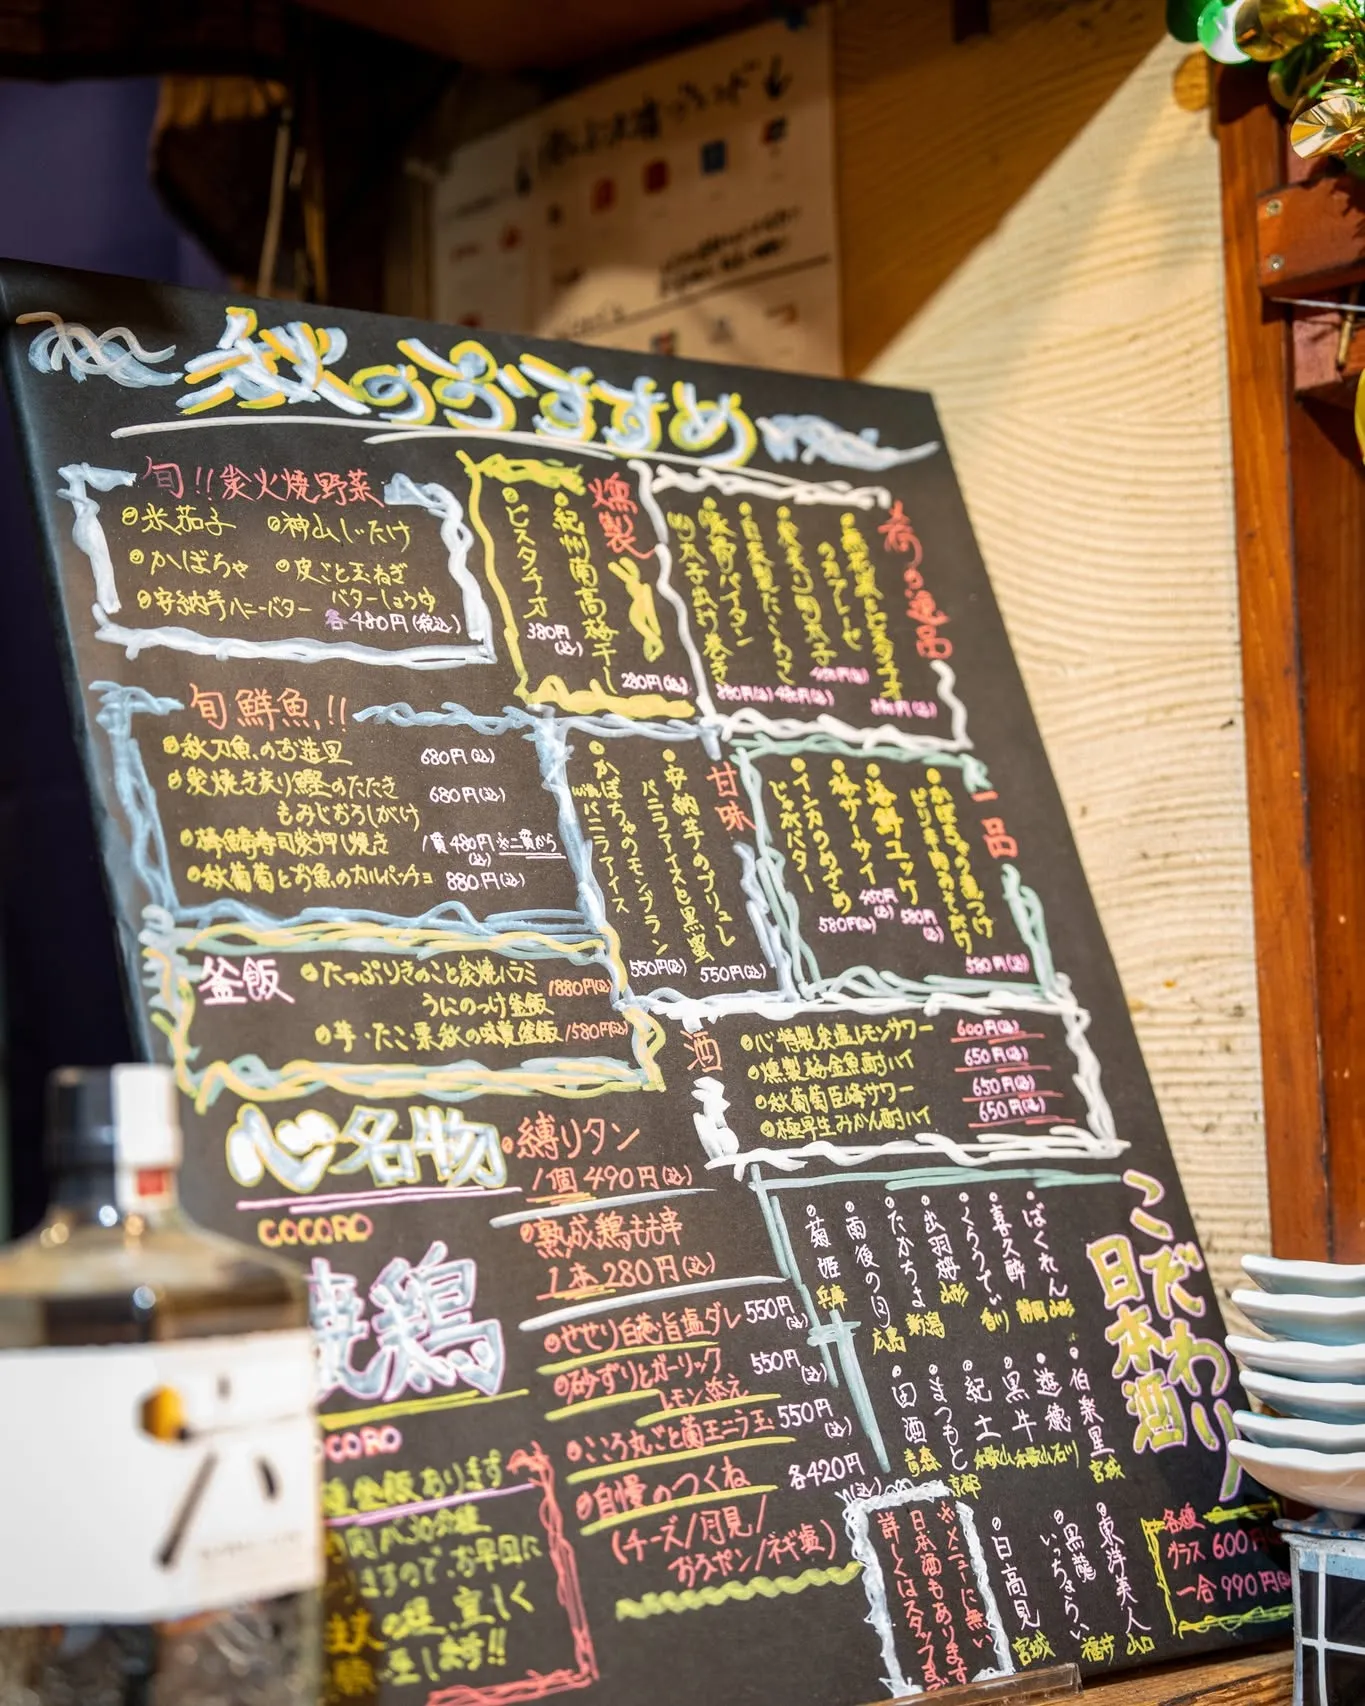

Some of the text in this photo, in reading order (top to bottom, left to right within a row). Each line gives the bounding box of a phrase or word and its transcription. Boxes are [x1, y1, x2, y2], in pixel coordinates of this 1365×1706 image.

[176, 306, 759, 467] 秋のおすすめ
[141, 503, 237, 537] 米茄子
[150, 549, 250, 580] かぼちゃ
[294, 556, 409, 586] 皮ごと玉ねぎ
[505, 503, 548, 619] ピスタチオ
[156, 586, 313, 622] 安納芋ハニーバター
[331, 586, 437, 612] バターしょうゆ
[276, 800, 420, 833] もみじおろしがけ
[706, 760, 758, 832] 甘味
[583, 801, 630, 914] バニラアイス
[592, 758, 669, 957] かぼちゃのモンブラン
[663, 765, 736, 947] 安納芋のブリュレ
[199, 955, 296, 1006] 釜飯
[422, 992, 554, 1018] うにのっけ釜飯
[683, 1030, 724, 1073] 酒
[257, 1212, 374, 1248] COCORO
[887, 1209, 926, 1308] たかちよ
[1021, 1201, 1069, 1297] ばくれん
[871, 1325, 907, 1356] 広島
[1086, 1234, 1188, 1455] 日本酒
[1123, 1168, 1243, 1501] こだわり
[891, 1381, 943, 1478] 田酒 青森
[929, 1377, 984, 1500] まつもと 京都
[963, 1375, 1002, 1442] 紀土
[1001, 1370, 1038, 1443] 黒牛
[323, 1424, 403, 1463] CORO
[1088, 1455, 1127, 1484] 宮城
[592, 1455, 751, 1520] 自慢のつくね
[1063, 1523, 1097, 1583] 黒龍
[1098, 1516, 1157, 1656] 東洋美人 山口
[1167, 1540, 1207, 1570] グラス
[877, 1511, 950, 1691] 詳しくはスタッフまで
[909, 1509, 969, 1685] 日本酒もあります
[990, 1535, 1057, 1667] 日高見 宮城
[1039, 1533, 1115, 1665] いっちょらい 福井
[1176, 1573, 1218, 1604] 一合
